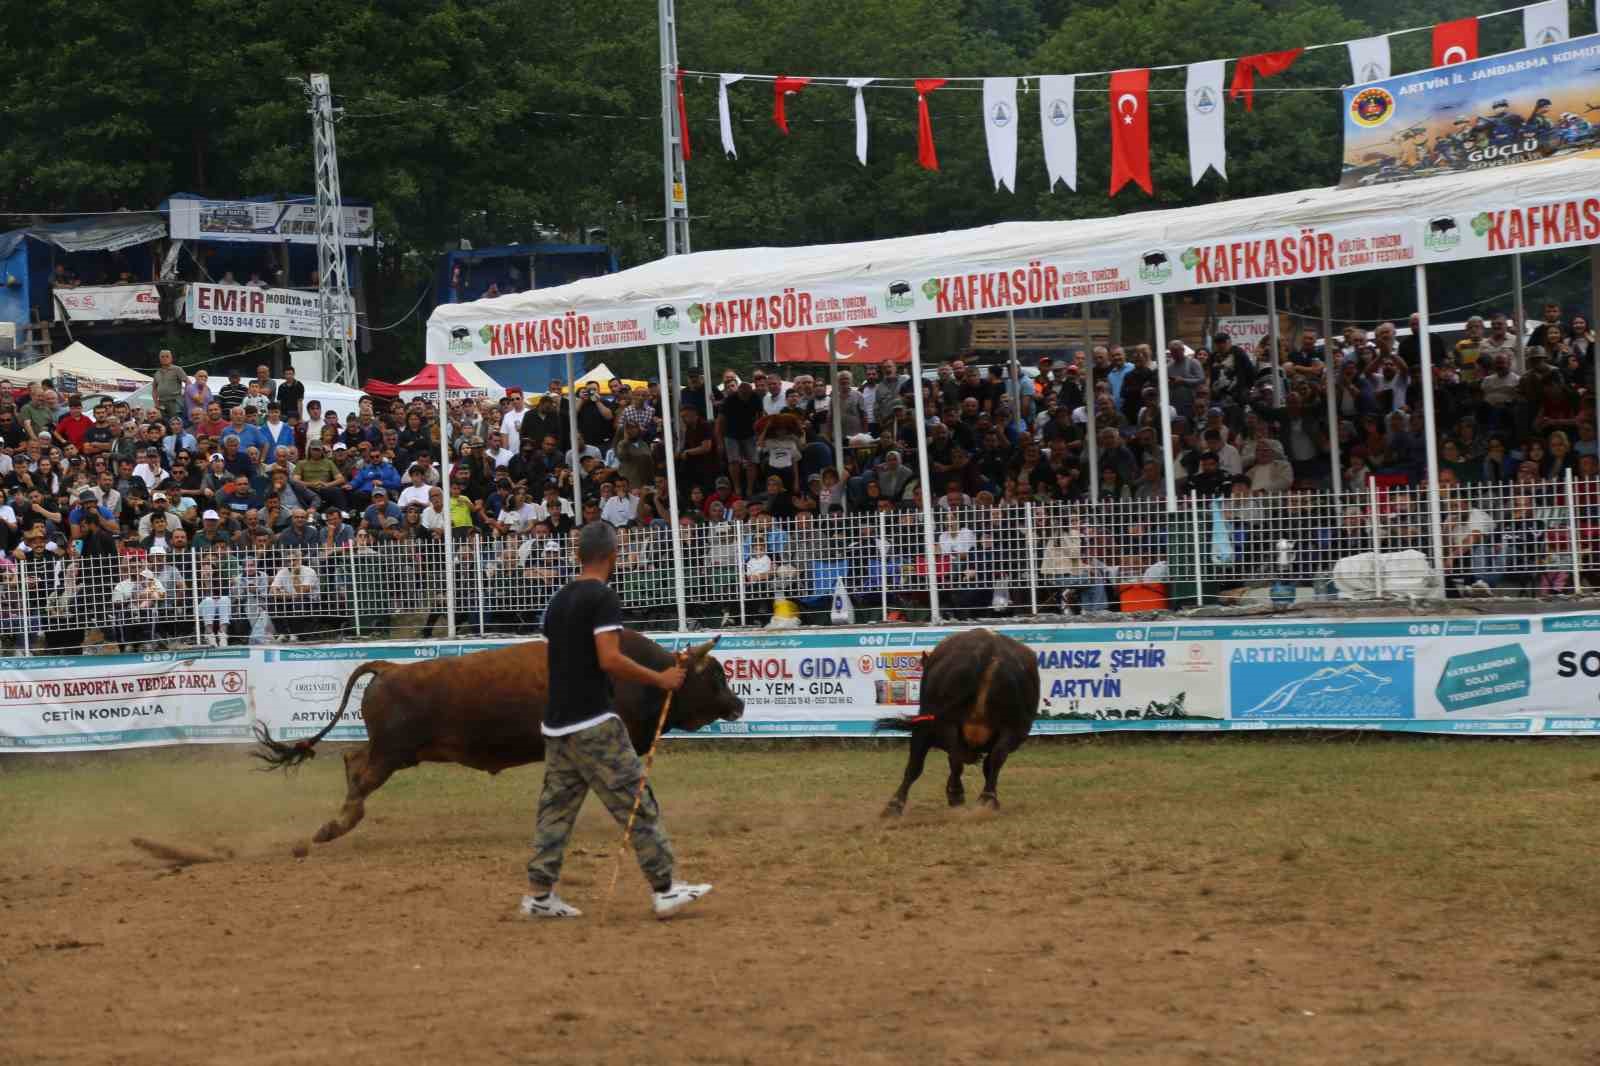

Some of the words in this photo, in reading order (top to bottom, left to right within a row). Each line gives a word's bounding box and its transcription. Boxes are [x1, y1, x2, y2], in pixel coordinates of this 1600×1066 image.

[1399, 75, 1449, 96] ARTVİN
[1452, 72, 1466, 85] İL
[1469, 57, 1549, 82] JANDARMA
[1467, 137, 1539, 162] GÜÇLÜ
[1195, 229, 1336, 285] KAFKASÖR
[266, 293, 301, 307] MOBİLYA
[936, 261, 1059, 313] KAFKASÖR
[211, 315, 234, 326] 0535
[237, 316, 254, 327] 944
[256, 318, 267, 329] 56
[269, 318, 280, 329] 78
[700, 287, 813, 336] KAFKASÖR
[489, 311, 591, 356] KAFKASÖR
[463, 386, 488, 398] YERİ
[1109, 643, 1166, 674] ŞEHİR
[1232, 643, 1325, 663] ARTRİUM
[1333, 646, 1416, 662] AVM'YE
[1557, 650, 1600, 678] SO
[723, 658, 793, 682] ŞENOL
[800, 656, 852, 679] GIDA
[4, 681, 32, 699] İMAJ
[36, 683, 60, 698] OTO
[63, 679, 119, 697] KAPORTA
[121, 682, 135, 693] ve
[137, 674, 177, 692] YEDEK
[179, 673, 216, 695] PARÇA
[765, 682, 795, 696] YEM
[809, 682, 844, 695] GIDA
[1050, 673, 1121, 698] ARTVİN
[89, 703, 164, 720] KONDAL'A
